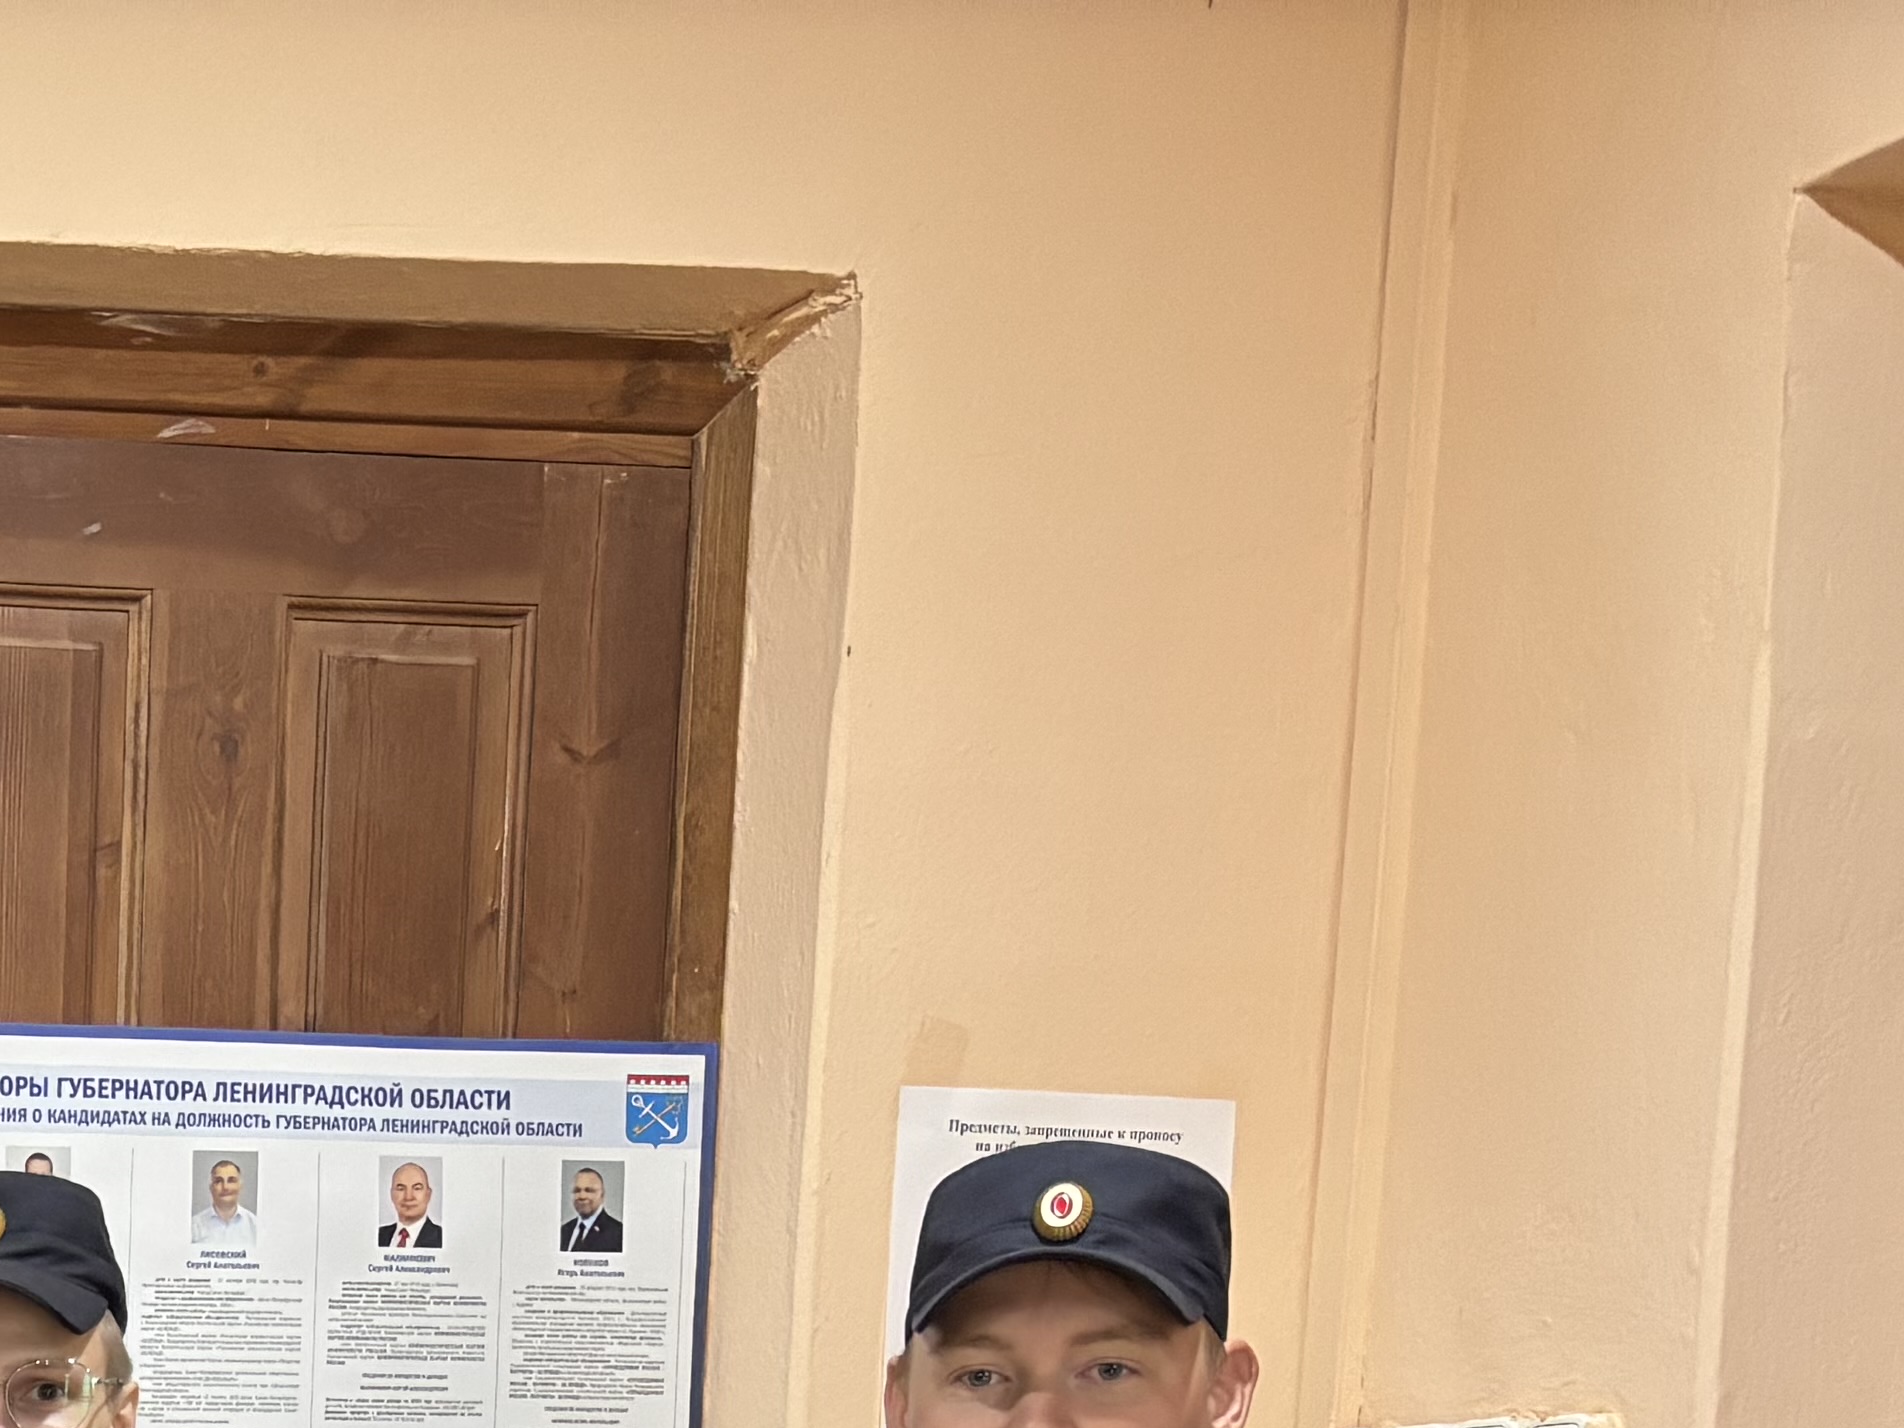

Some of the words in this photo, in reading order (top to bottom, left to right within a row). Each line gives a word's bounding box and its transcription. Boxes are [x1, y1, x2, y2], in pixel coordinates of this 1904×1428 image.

[56, 1076, 208, 1102] ГУБЕРНАТОРА
[212, 1080, 404, 1110] ЛЕНИНГРАДСКОЙ
[410, 1088, 512, 1111] ОБЛАСТИ
[31, 1107, 43, 1124] О
[47, 1109, 147, 1128] КАНДИДАТАХ
[151, 1112, 171, 1128] НА
[174, 1112, 271, 1130] ДОЛЖНОСТЬ
[275, 1115, 377, 1133] ГУБЕРНАТОРА
[380, 1117, 511, 1137] ЛЕНИНГРАДСКОЙ
[515, 1121, 583, 1138] ОБЛАСТИ
